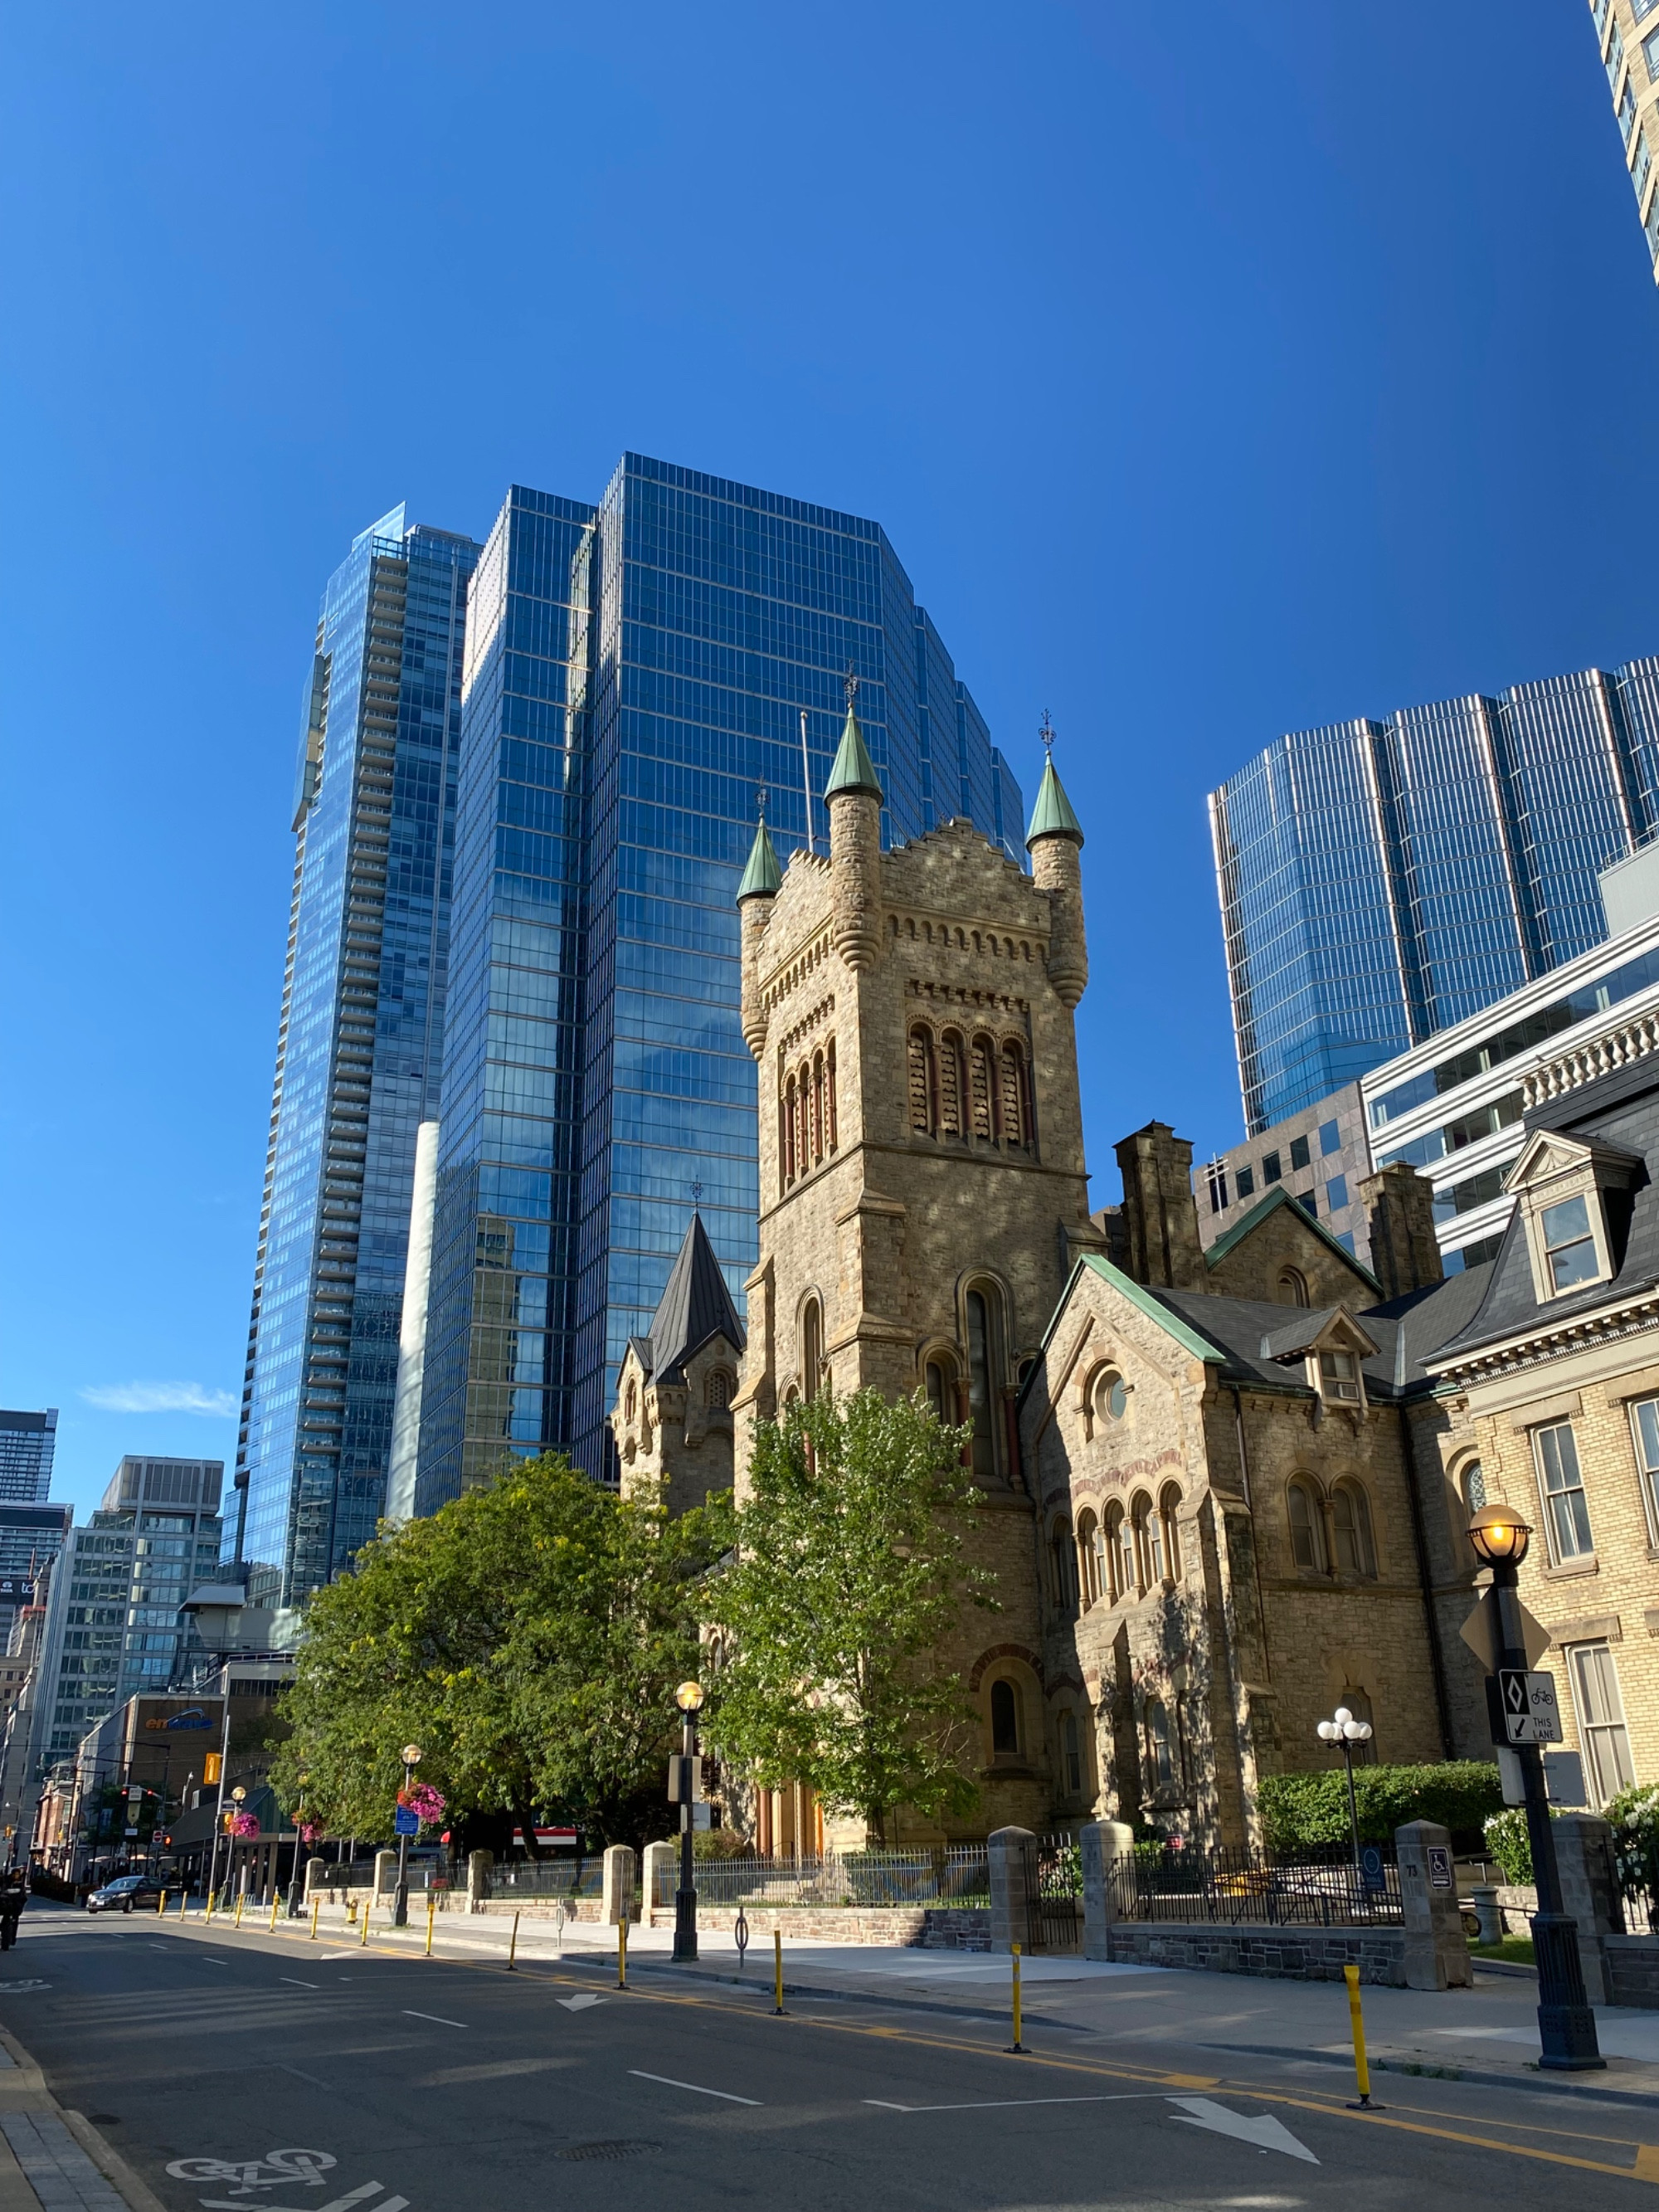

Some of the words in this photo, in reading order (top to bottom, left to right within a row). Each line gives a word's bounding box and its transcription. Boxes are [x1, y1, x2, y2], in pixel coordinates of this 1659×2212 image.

[1533, 1717, 1552, 1727] THIS
[1533, 1730, 1554, 1739] LANE
[1406, 1864, 1418, 1877] 73
